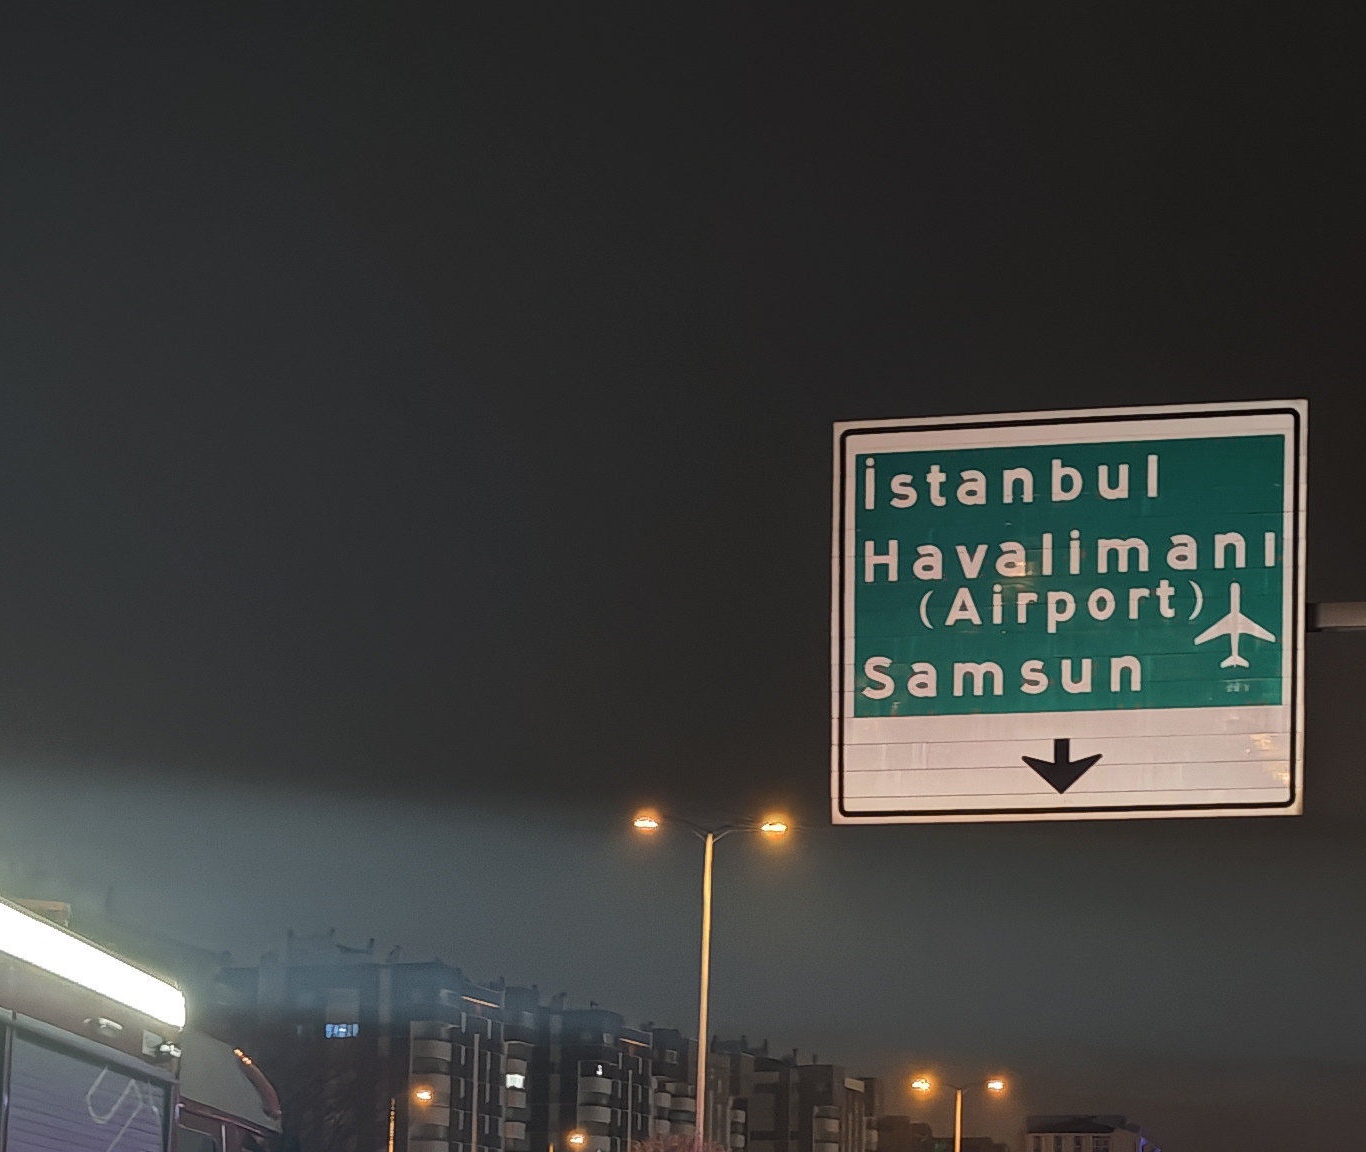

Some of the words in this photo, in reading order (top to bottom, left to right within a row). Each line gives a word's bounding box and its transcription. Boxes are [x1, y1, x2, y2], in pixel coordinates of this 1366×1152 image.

[864, 454, 1159, 510] İstanbul
[864, 529, 1277, 583] Havalimanı
[919, 579, 1204, 634] (Airport)
[862, 655, 1142, 700] Samsun
